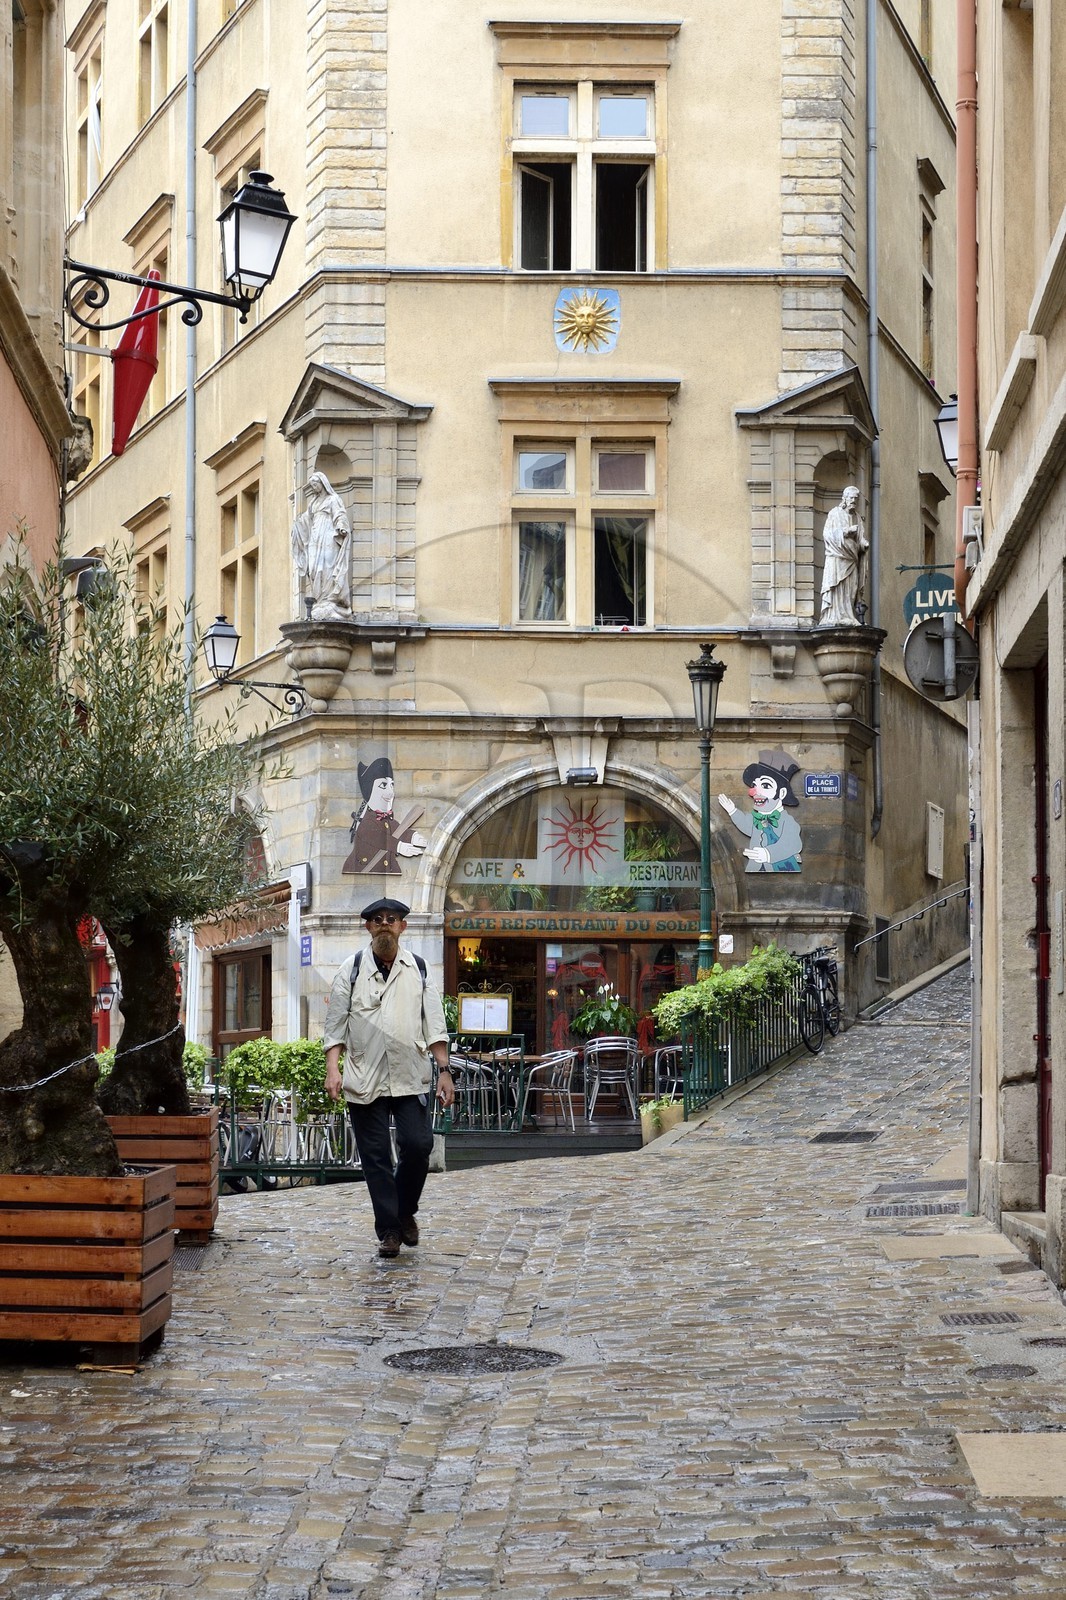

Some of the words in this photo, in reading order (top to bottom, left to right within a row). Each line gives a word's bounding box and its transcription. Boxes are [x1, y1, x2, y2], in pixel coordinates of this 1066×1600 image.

[463, 861, 504, 878] CAFE
[512, 862, 525, 879] &
[629, 864, 701, 881] RESTAURAN
[449, 917, 496, 931] CAFE
[501, 917, 619, 932] RESTAURANT
[625, 919, 650, 932] DU
